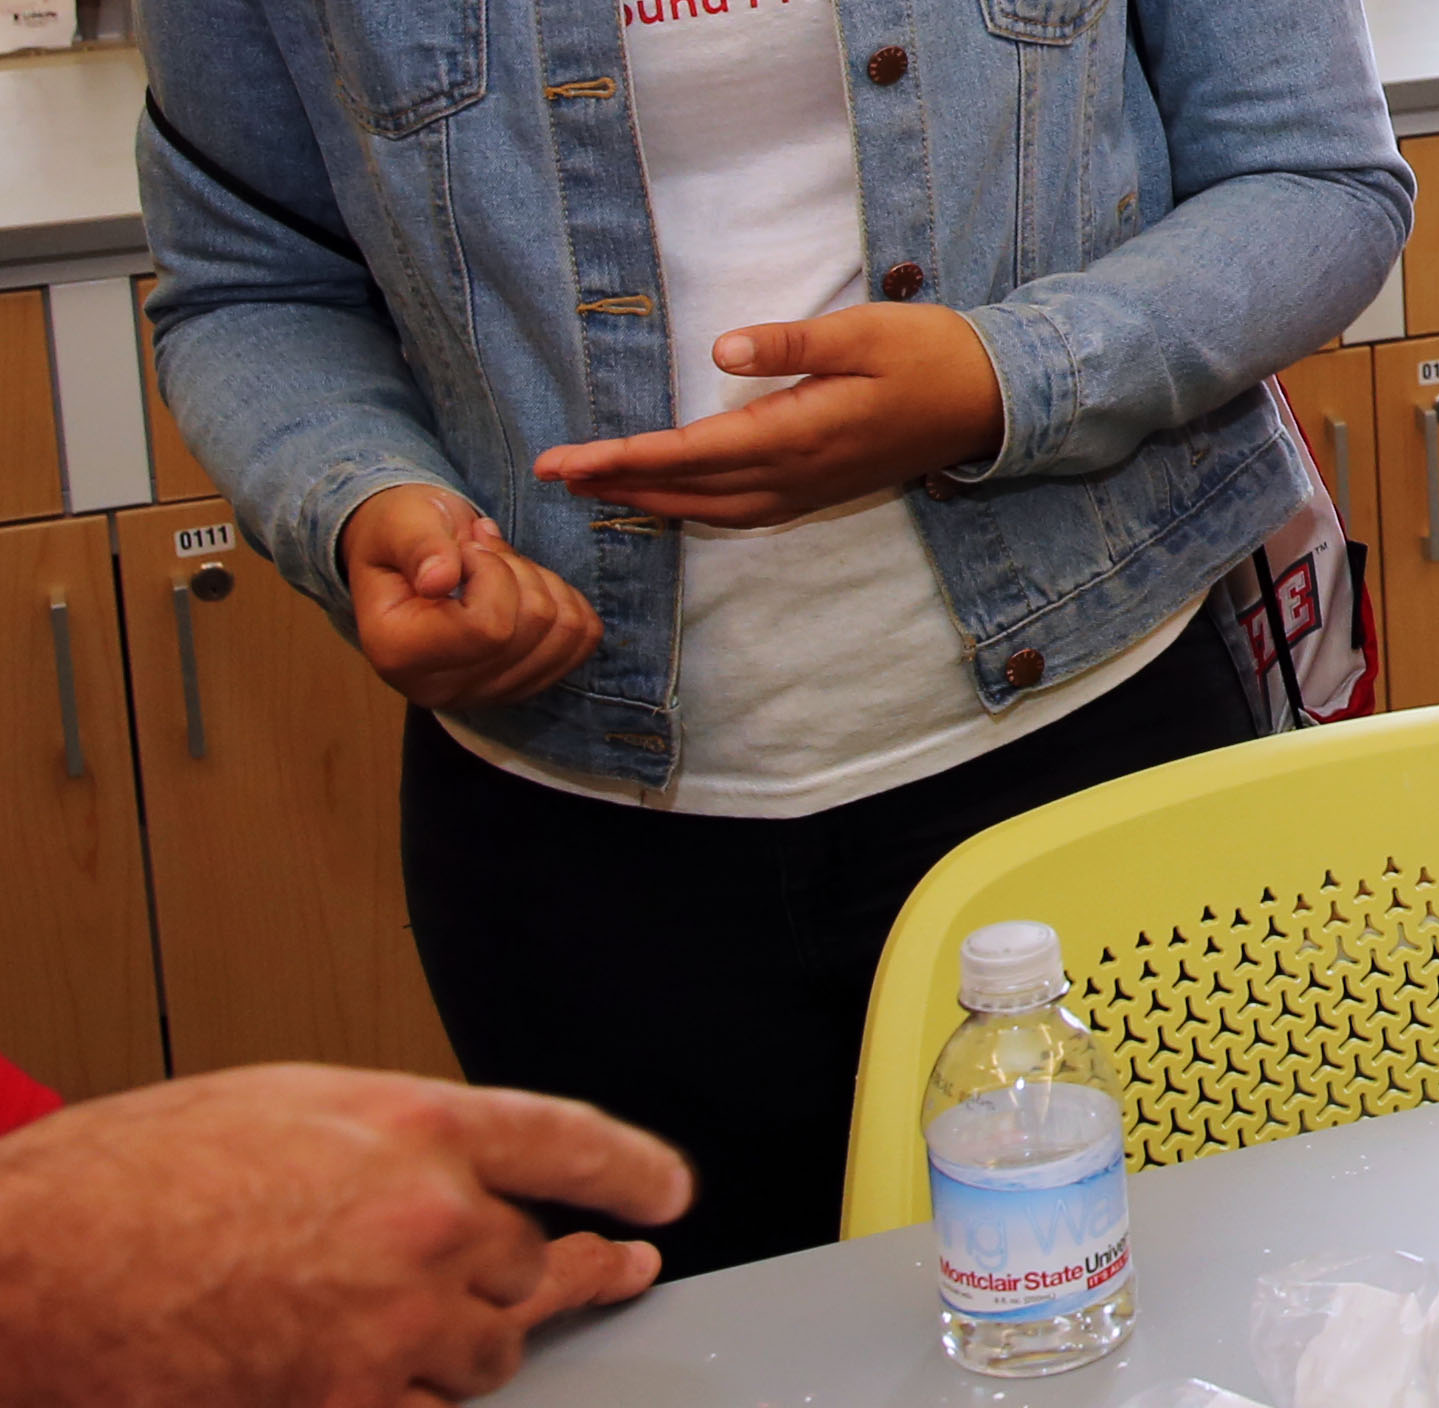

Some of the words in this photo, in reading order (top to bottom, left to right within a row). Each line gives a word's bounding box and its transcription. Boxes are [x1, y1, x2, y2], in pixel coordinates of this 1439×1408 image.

[179, 525, 229, 551] 0111
[939, 1255, 1021, 1291] Montclair
[1024, 1263, 1083, 1291] State
